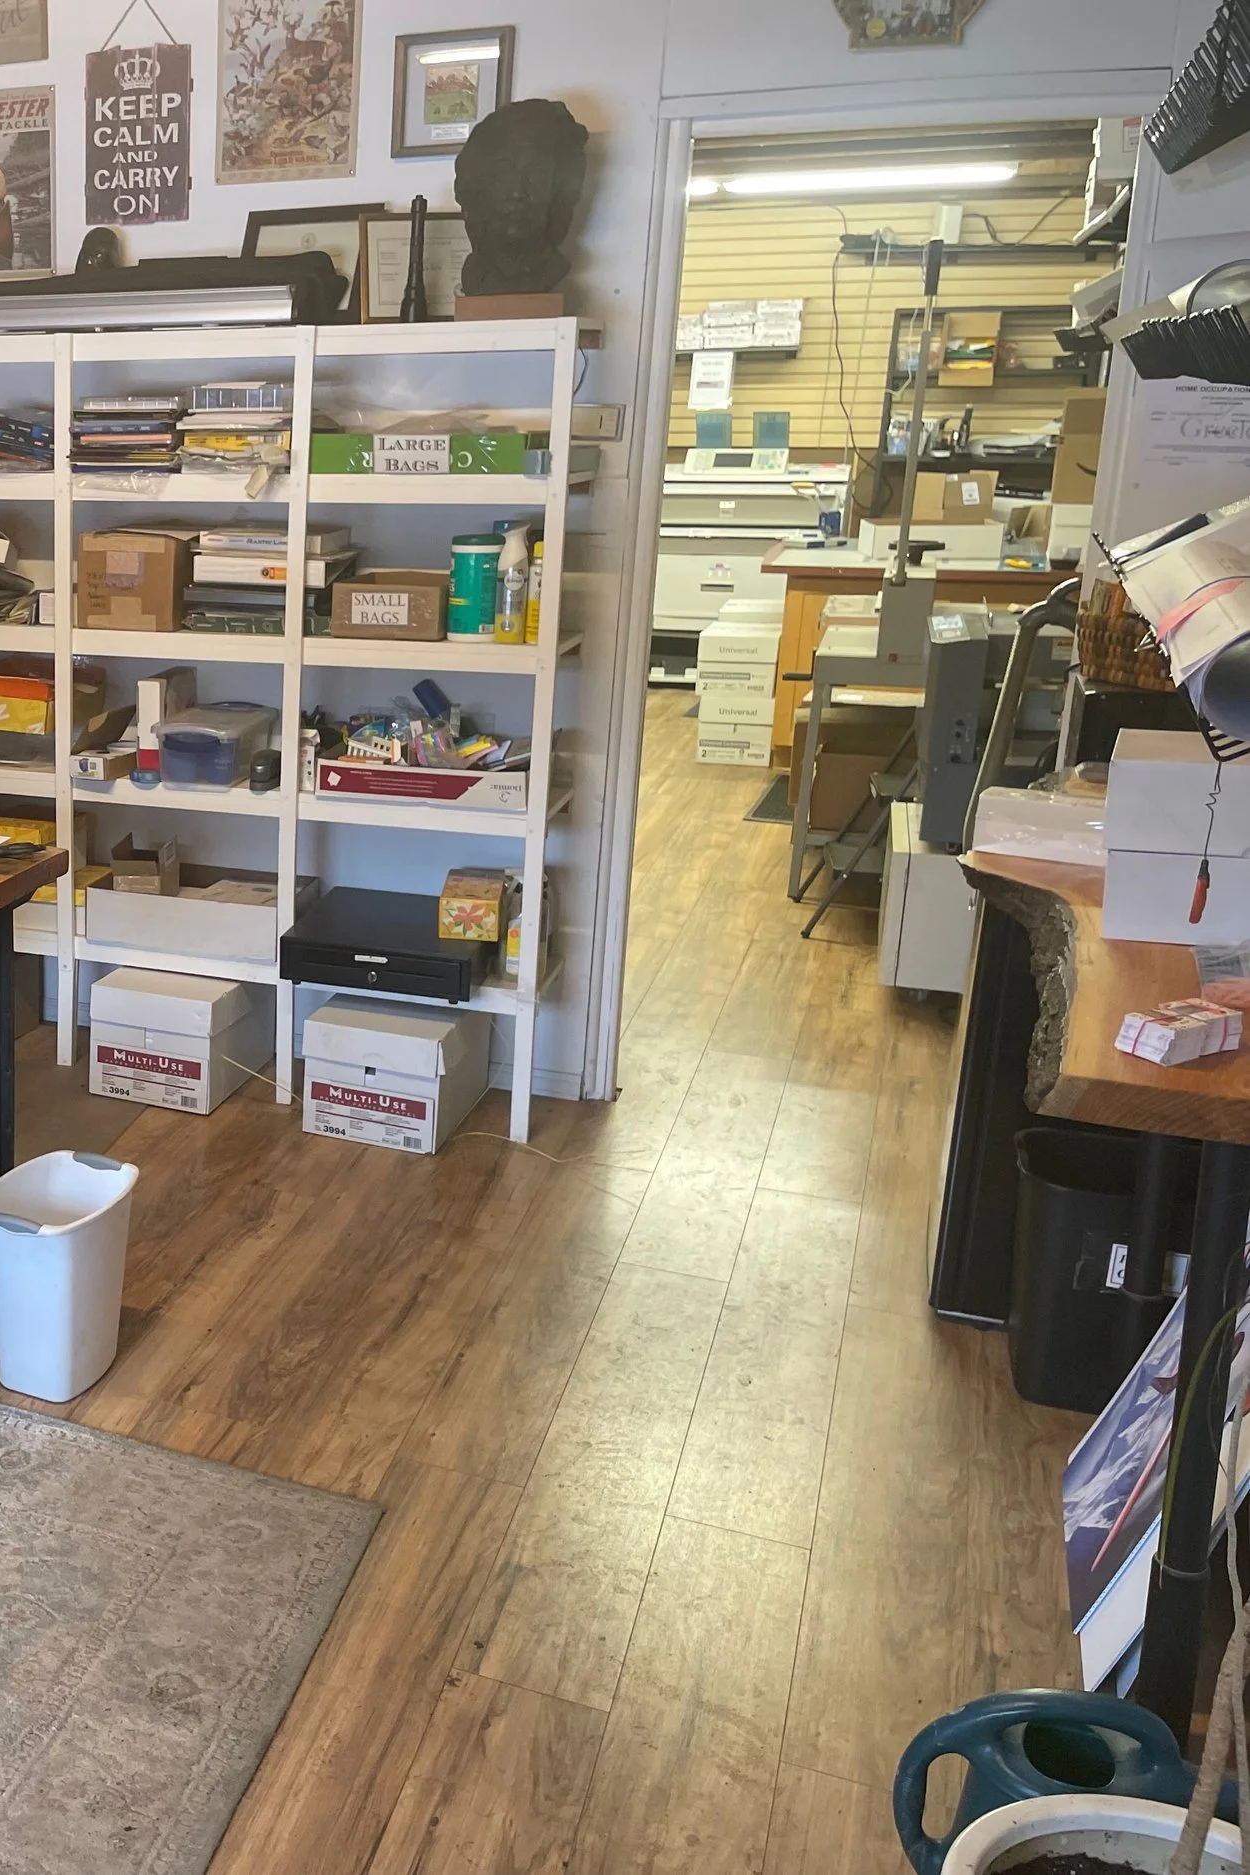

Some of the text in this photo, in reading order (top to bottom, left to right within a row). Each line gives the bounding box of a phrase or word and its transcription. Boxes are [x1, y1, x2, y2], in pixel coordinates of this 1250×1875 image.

[95, 92, 182, 122] KEEP
[93, 122, 179, 148] CALM
[112, 150, 158, 164] AND
[93, 165, 180, 190] CARRY
[113, 193, 160, 216] ON
[1175, 385, 1199, 393] HOME
[378, 437, 446, 451] LARGE
[385, 458, 440, 472] BAGS
[354, 593, 406, 607] SMALL
[360, 611, 400, 625] BAGS
[719, 646, 758, 655] Universal
[719, 707, 758, 717] Universal
[109, 1086, 130, 1097] 3994
[323, 1125, 346, 1136] 3994
